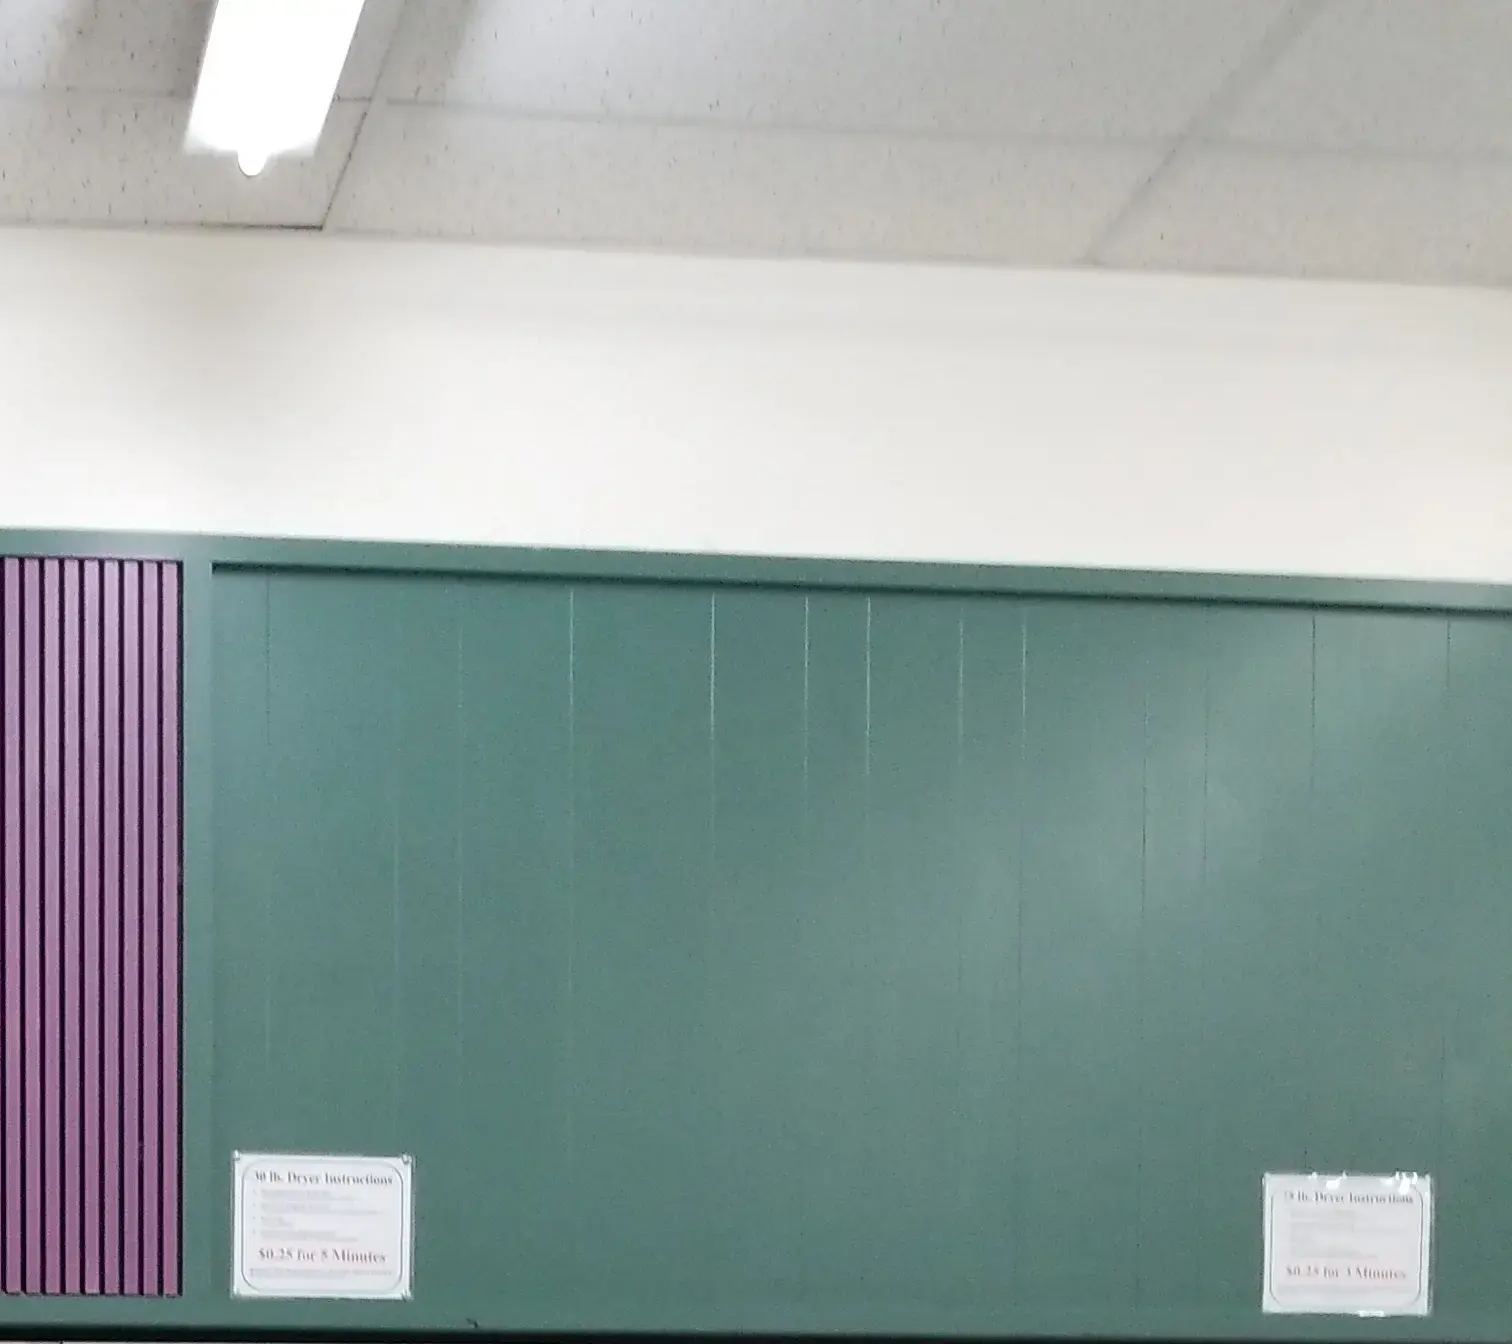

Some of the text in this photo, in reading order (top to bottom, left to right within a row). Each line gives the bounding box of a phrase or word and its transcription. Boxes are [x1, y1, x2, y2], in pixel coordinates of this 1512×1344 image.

[288, 1171, 320, 1185] Dryer
[325, 1171, 394, 1186] Instructions
[297, 1248, 315, 1262] for
[333, 1248, 387, 1264] Minutes
